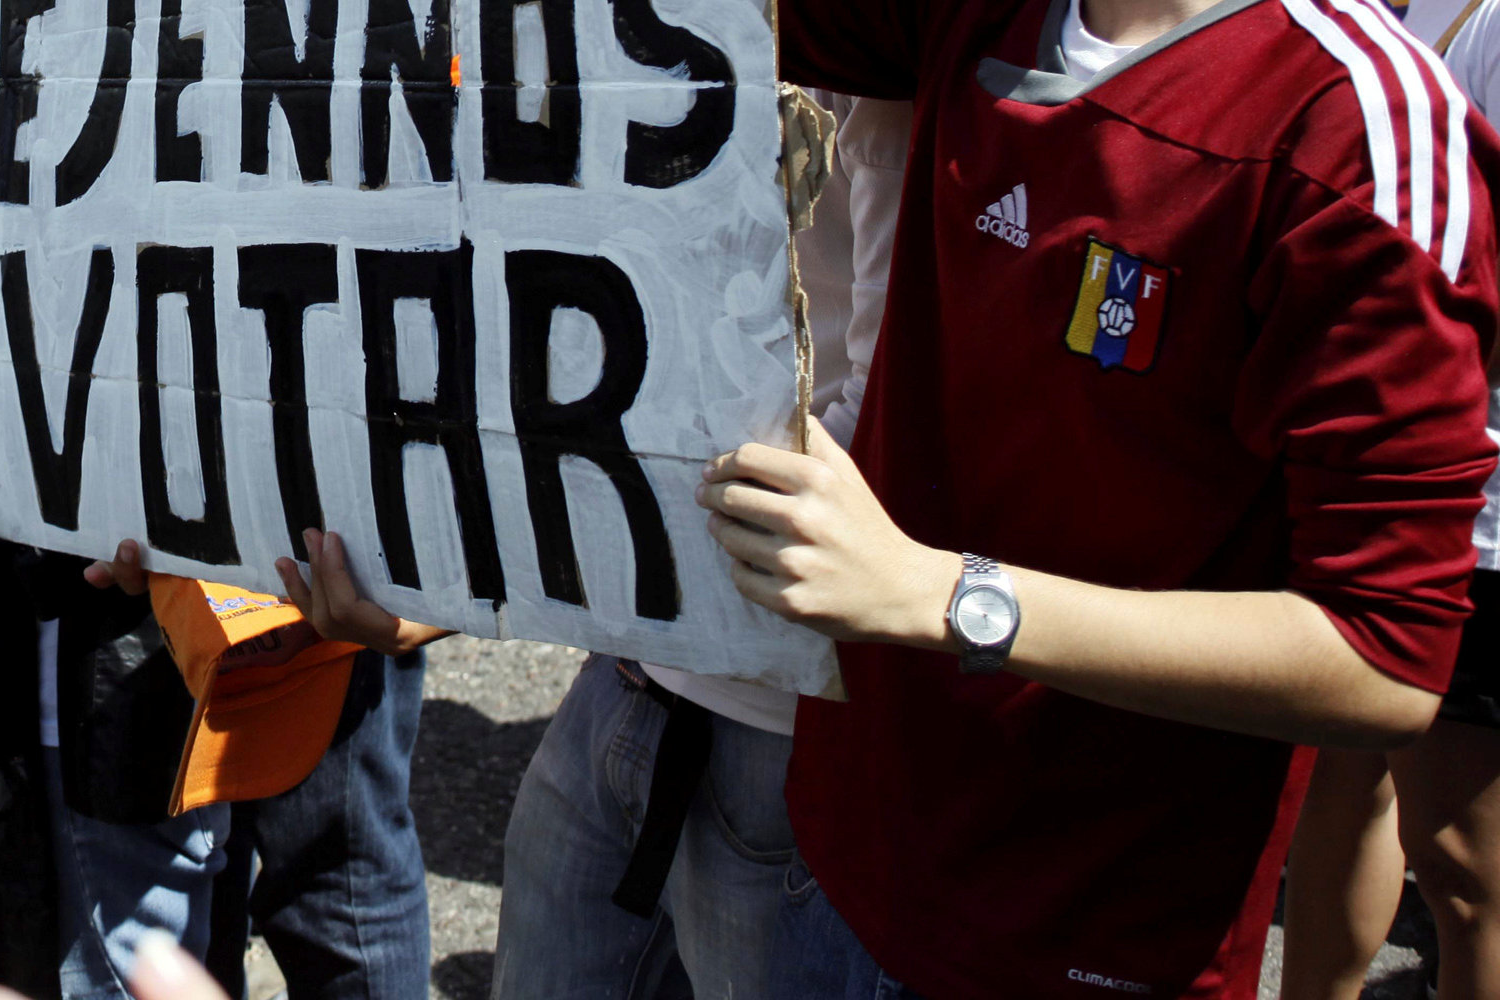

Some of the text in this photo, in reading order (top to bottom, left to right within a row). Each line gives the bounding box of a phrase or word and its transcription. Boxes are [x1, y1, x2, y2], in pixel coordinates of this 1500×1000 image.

[975, 214, 1031, 249] adidas
[1088, 254, 1162, 299] FVF
[0, 236, 682, 622] VOTAR
